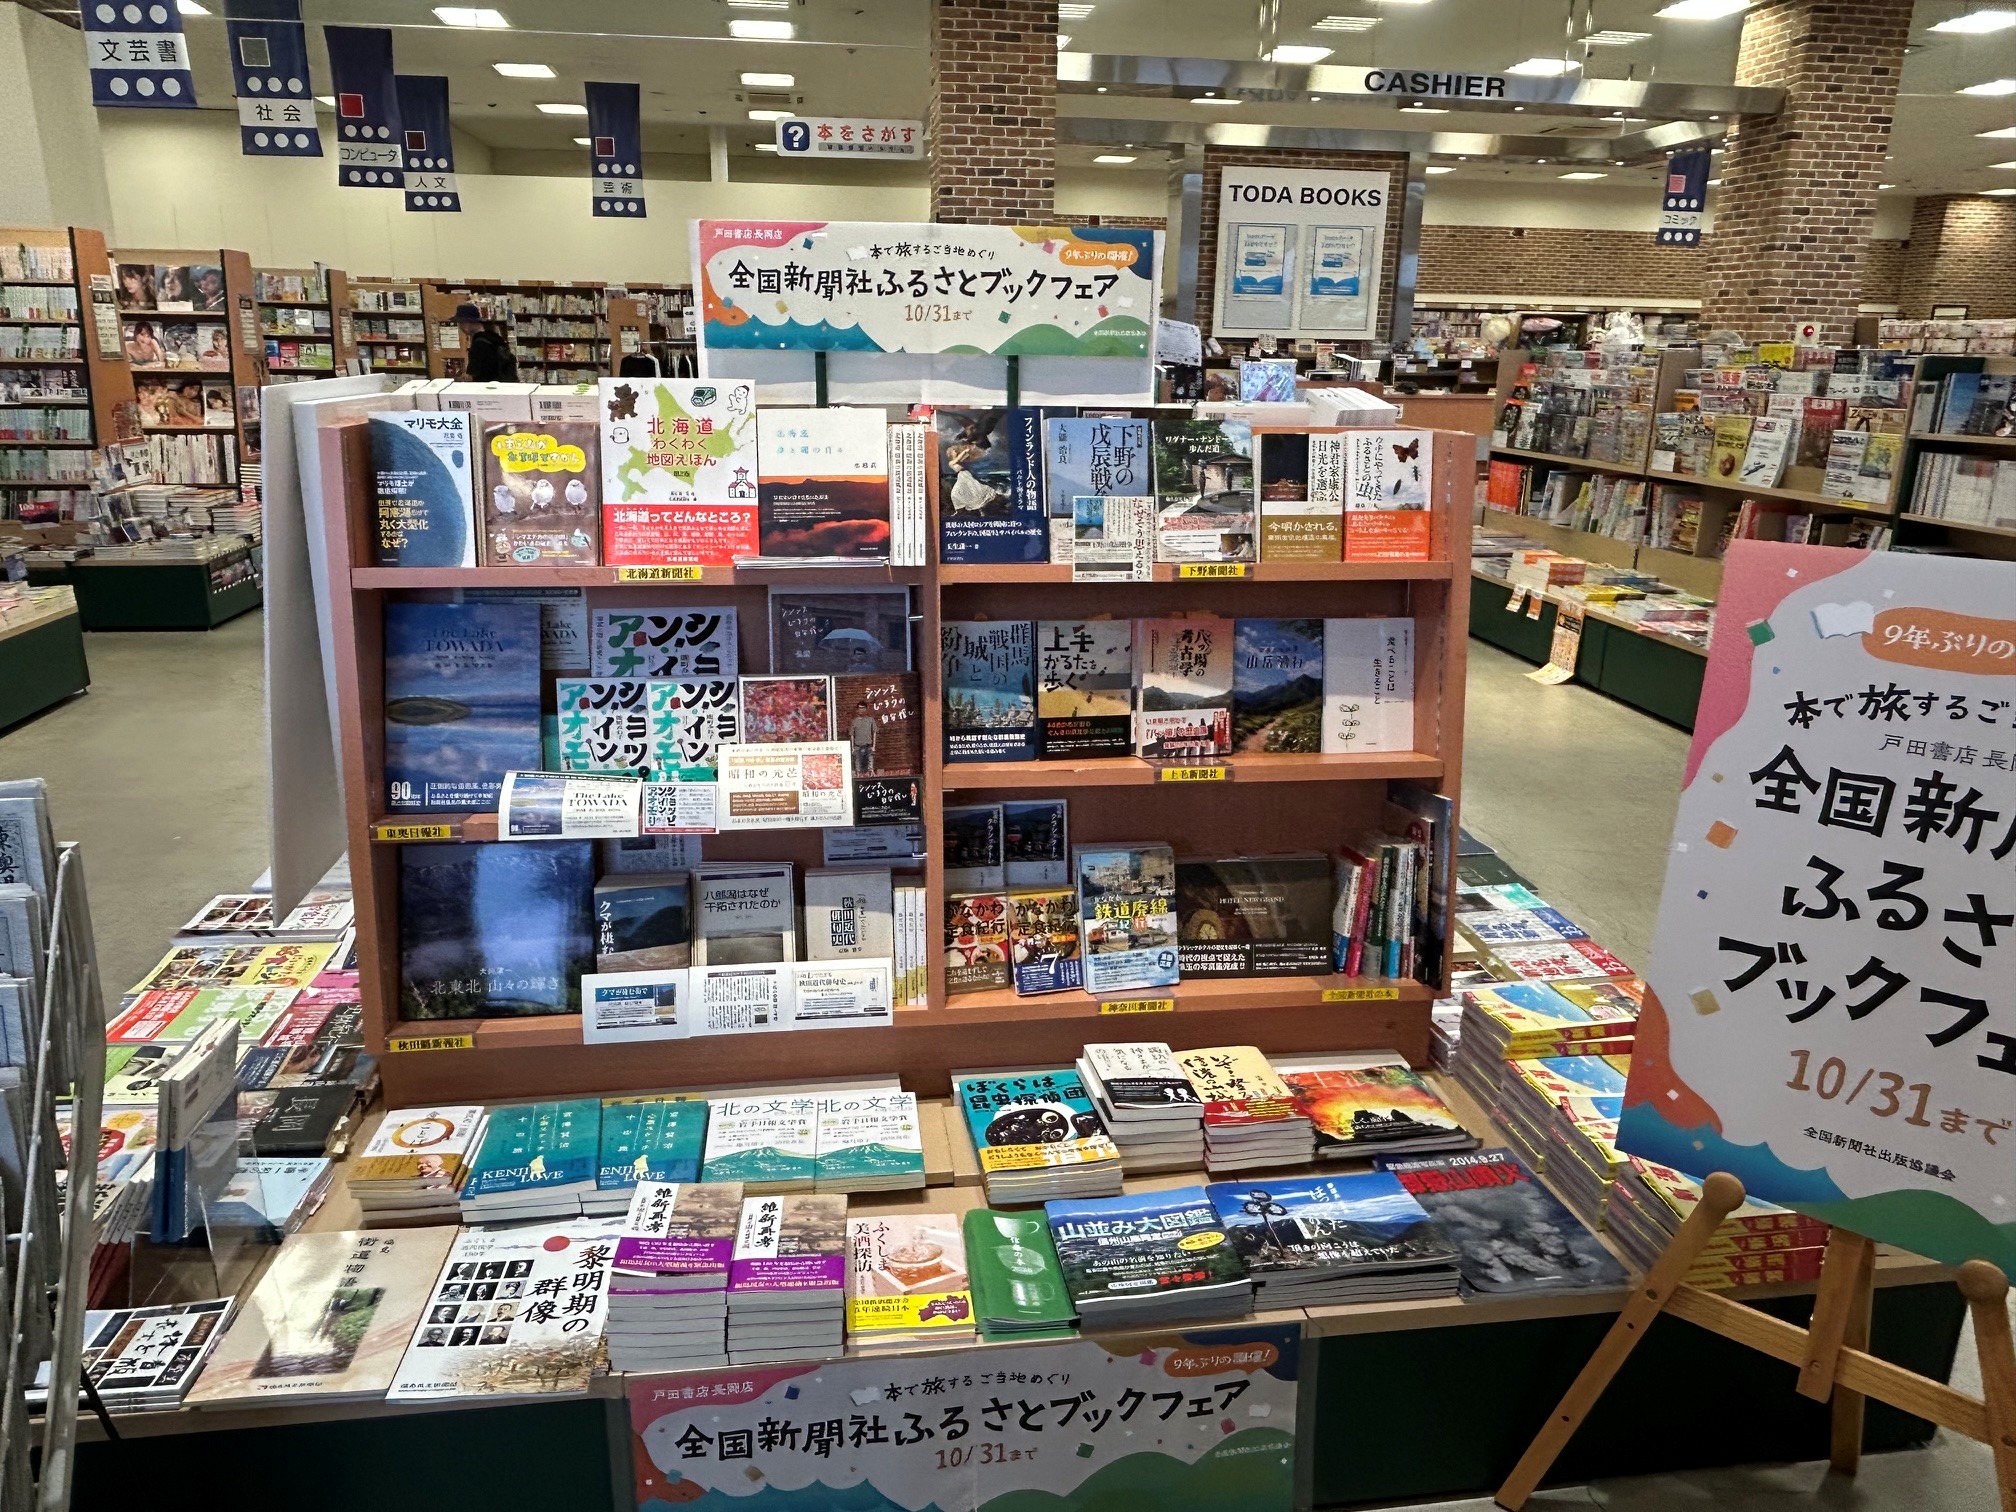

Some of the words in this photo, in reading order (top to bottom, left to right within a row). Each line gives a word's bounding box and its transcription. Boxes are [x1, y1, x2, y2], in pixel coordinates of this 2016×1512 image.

[101, 39, 178, 62] 文芸書
[1365, 70, 1506, 98] CASHIER
[256, 104, 301, 122] 社会
[817, 123, 916, 143] 本をさがす
[340, 146, 398, 164] コンピュータ
[415, 175, 447, 190] 人文
[1228, 184, 1293, 205] TODA
[1300, 187, 1382, 207] BOOKS
[714, 228, 783, 241] 戸田書店長岡店
[728, 260, 1120, 303] 全国新聞社ふるさとブックフェア
[905, 305, 973, 323] 10/31まで
[646, 417, 714, 435] 北海道
[652, 437, 707, 450] わくわく
[646, 453, 717, 467] 地図えほん
[1023, 417, 1037, 511] フィンランド人の物語
[1112, 424, 1136, 486] 下野の
[626, 566, 694, 579] 北海道新聞社
[1187, 565, 1238, 576] 下野新聞社
[1783, 683, 2016, 729] 本で旅するご
[1878, 733, 2016, 771] 戸田書店長
[391, 781, 411, 800] 90
[569, 798, 629, 808] TOWADA
[1748, 744, 2016, 862] 全国新
[385, 827, 443, 839] 東奥日報社
[1094, 898, 1169, 920] 鉄道廃線
[1781, 854, 2015, 969] ふるさ
[1040, 952, 1060, 974] 7
[430, 978, 482, 996] 北東北
[966, 1076, 1056, 1094] ぼくらは
[816, 1095, 913, 1114] 北の文学
[969, 1087, 1087, 1110] 昆虫探偵団
[1786, 1049, 2013, 1146] 10/31まで
[716, 1099, 815, 1117] 北の文学
[1449, 1152, 1505, 1167] 2014.9.27
[1803, 1125, 1957, 1183] 全国新聞社出版協議会
[482, 1166, 531, 1179] KENJI
[521, 1170, 564, 1183] LOVE
[600, 1166, 632, 1177] ENJI
[623, 1170, 666, 1182] LOVE
[854, 1222, 873, 1273] 美酒探訪
[872, 1221, 891, 1272] ふくしま
[562, 1245, 614, 1334] 黎明期の
[521, 1276, 569, 1325] 群像
[652, 1381, 754, 1402] 戸田書店長岡店
[674, 1380, 1251, 1461] 全国新聞社ふるさとブックフェア
[935, 1443, 1039, 1470] 10/31まで
